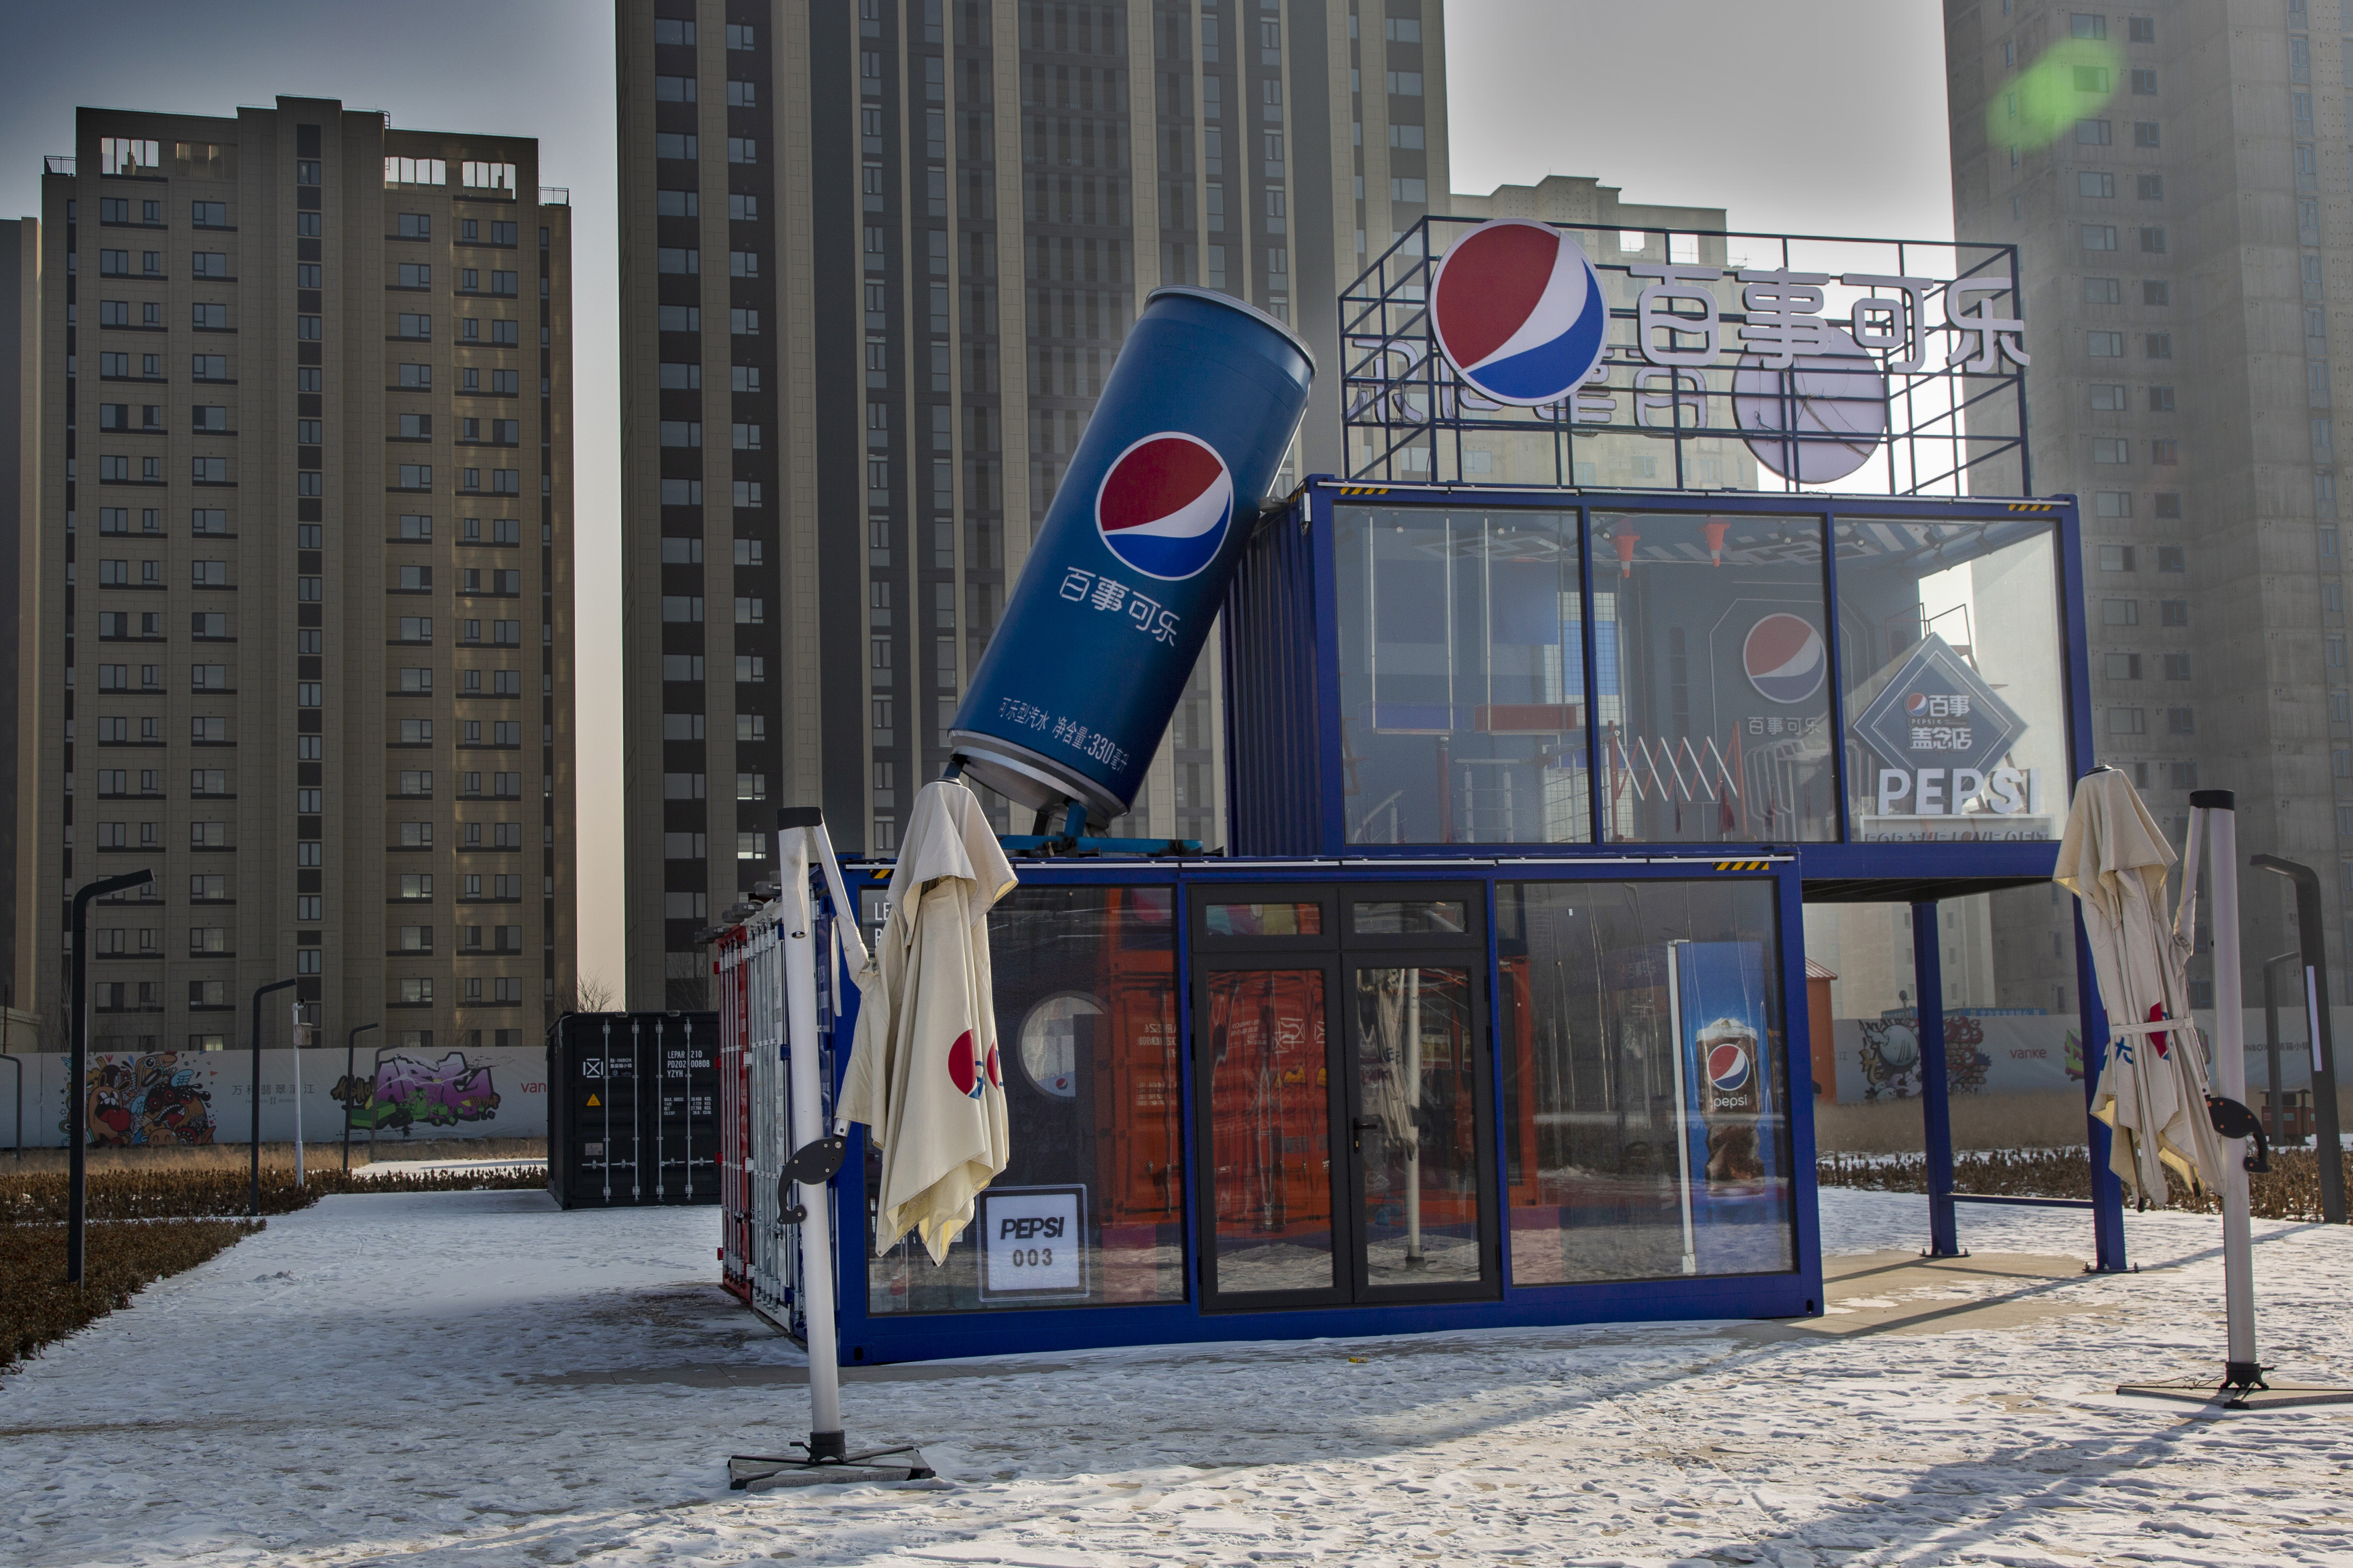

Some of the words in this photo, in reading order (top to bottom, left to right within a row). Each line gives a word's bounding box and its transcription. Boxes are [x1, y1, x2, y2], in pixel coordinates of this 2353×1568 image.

[1628, 264, 2031, 375] 百事可乐
[1059, 566, 1181, 647] 百事可乐
[999, 697, 1050, 731] 可乐型汽水
[1928, 694, 1971, 717] 百事
[1747, 716, 1822, 735] 百事可乐
[1909, 726, 1973, 751] 盖念店
[1878, 767, 2040, 815] PEPSI
[667, 1051, 685, 1059] LEPAR
[691, 1050, 703, 1058] 210
[2009, 1049, 2046, 1059] vanke
[667, 1070, 683, 1078] YZYH
[1713, 1094, 1747, 1109] pepsi
[1000, 1216, 1064, 1240] PEPSI
[1013, 1248, 1053, 1268] 003
